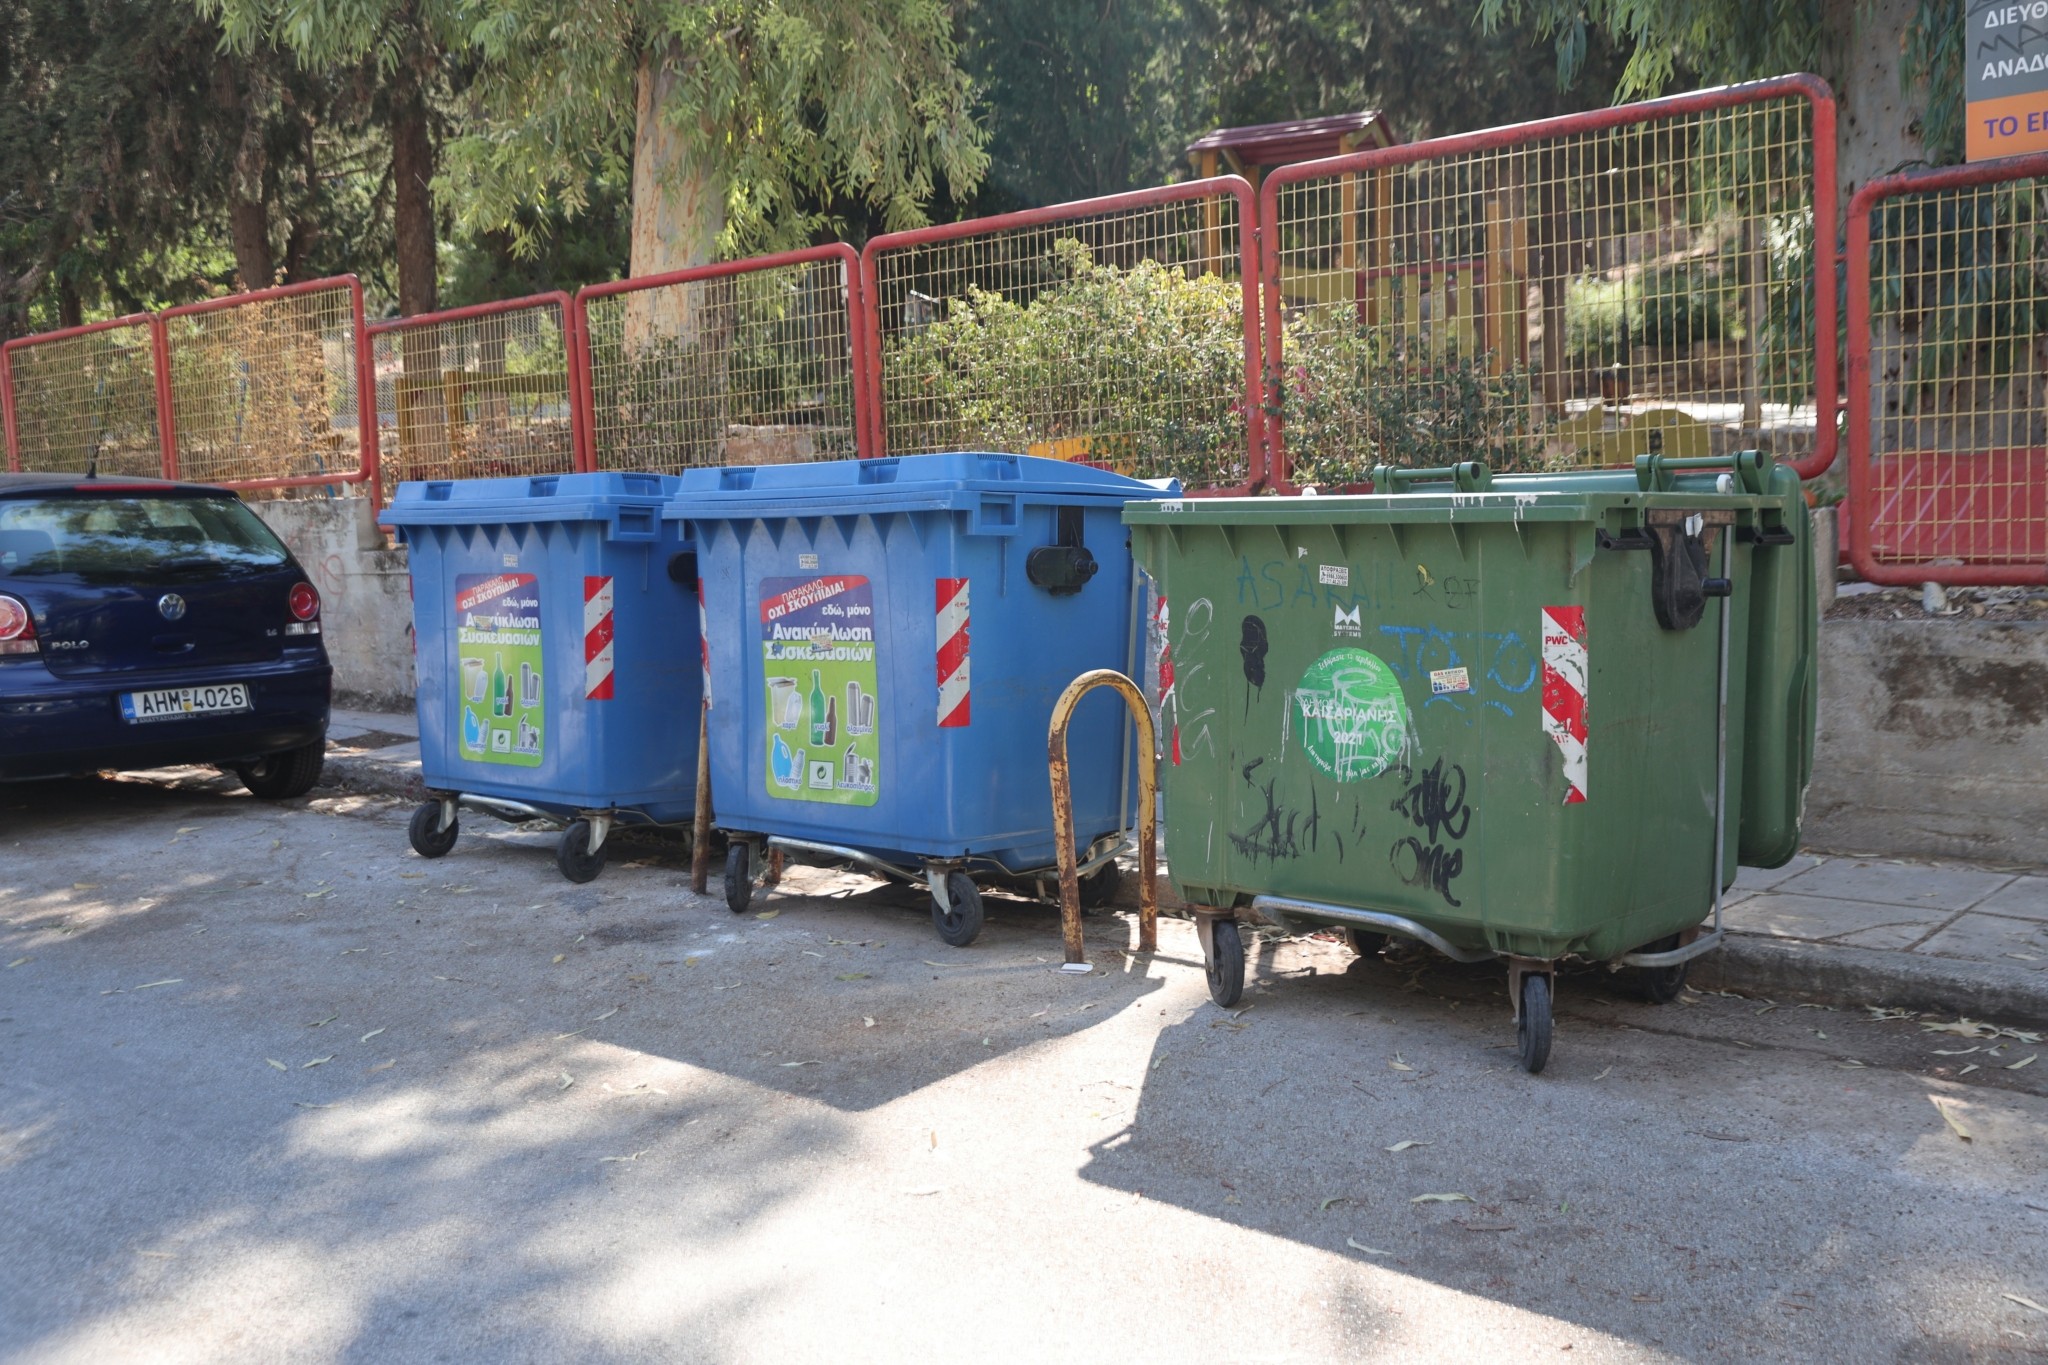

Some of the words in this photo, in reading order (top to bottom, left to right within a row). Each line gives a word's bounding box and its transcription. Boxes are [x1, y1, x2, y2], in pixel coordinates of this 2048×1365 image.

[1984, 1, 2048, 28] ΔΙΕΥΘ
[1982, 54, 2048, 80] ΑΝΑΔ
[1984, 116, 2018, 139] ΤΟ
[462, 596, 476, 609] ΟΧΙ
[477, 578, 520, 603] ΣΚΟΥΠΙΔΙΑ!
[768, 605, 786, 620] ΟΧΙ
[788, 581, 845, 612] ΣΚΟΥΠΙΔΙΑ!
[502, 597, 519, 608] εδώ,
[520, 597, 538, 609] μόνο
[822, 604, 844, 617] εδώ,
[847, 604, 871, 618] μόνο
[466, 612, 539, 628] Αύκλωση
[459, 628, 540, 645] Συσκευασιών
[1545, 635, 1568, 645] PWC
[51, 640, 90, 651] POLO
[1303, 706, 1396, 722] ΚΑΙΣΑΡΙΑΝΗΣ
[1334, 731, 1362, 745] 2021
